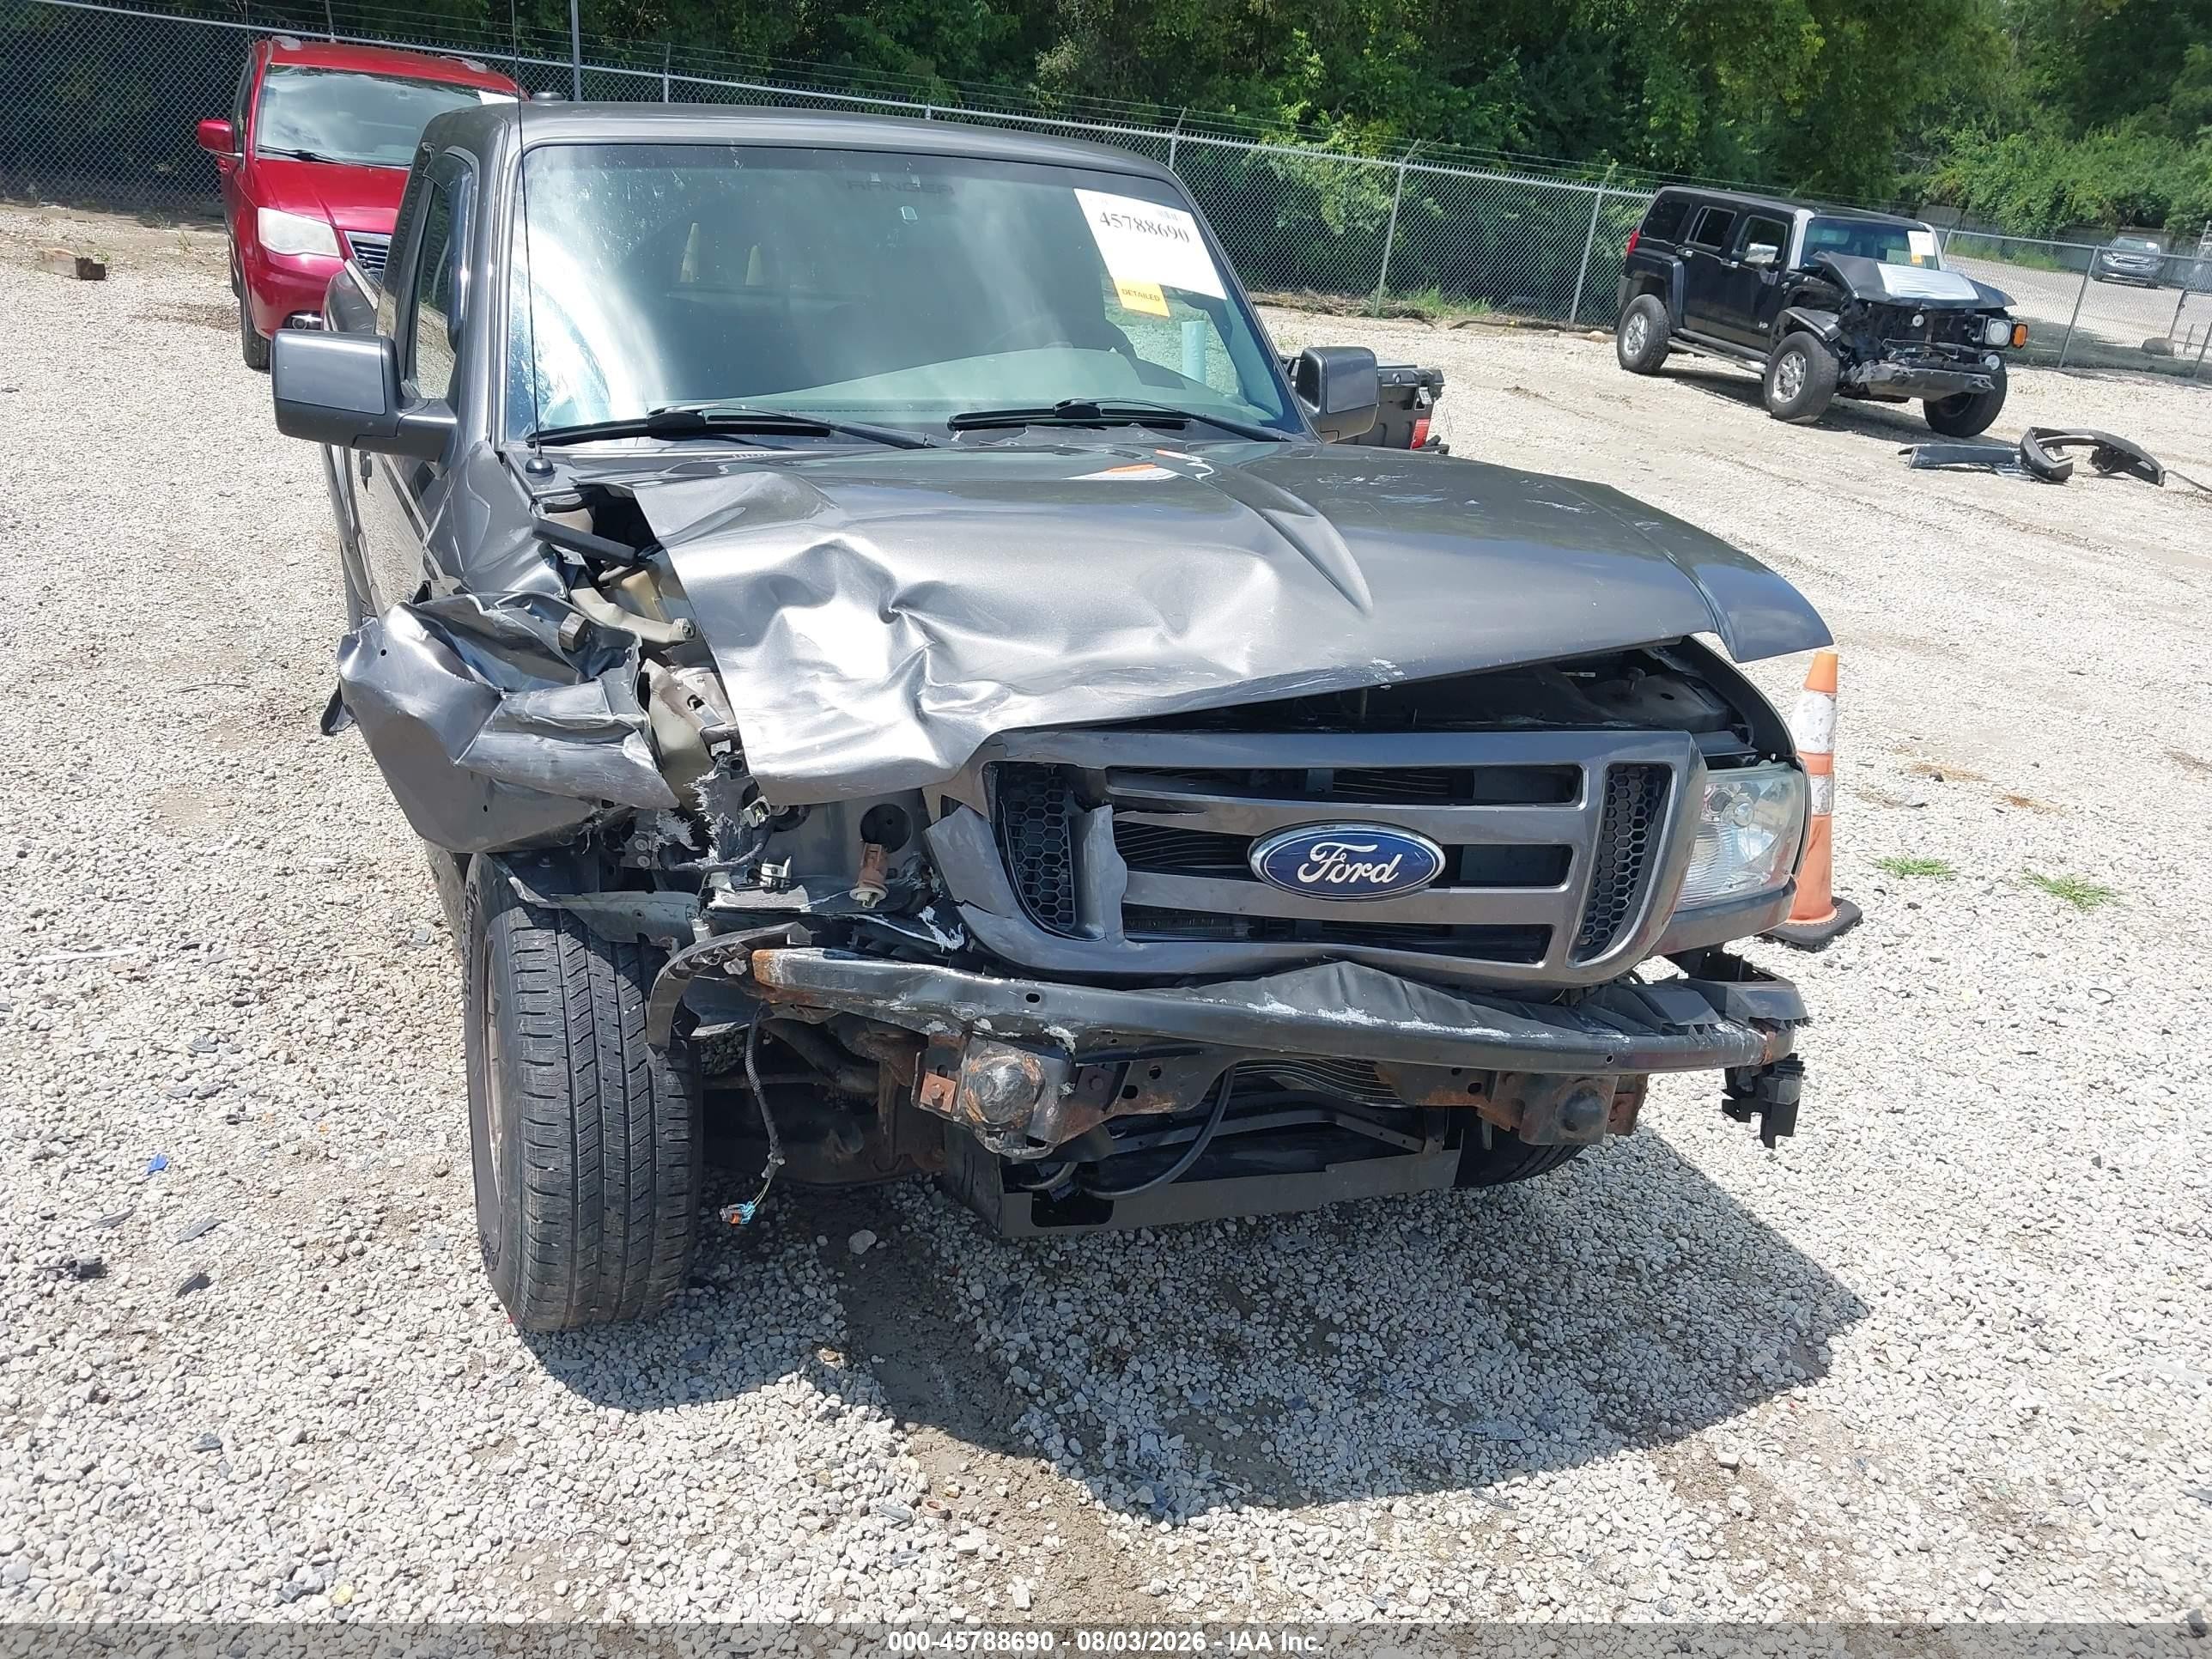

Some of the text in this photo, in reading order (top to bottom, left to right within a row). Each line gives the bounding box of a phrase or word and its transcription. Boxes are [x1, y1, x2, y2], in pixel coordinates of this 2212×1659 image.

[1099, 211, 1190, 244] 45788690
[1121, 288, 1161, 302] DETAILED
[1297, 842, 1403, 884] Ford
